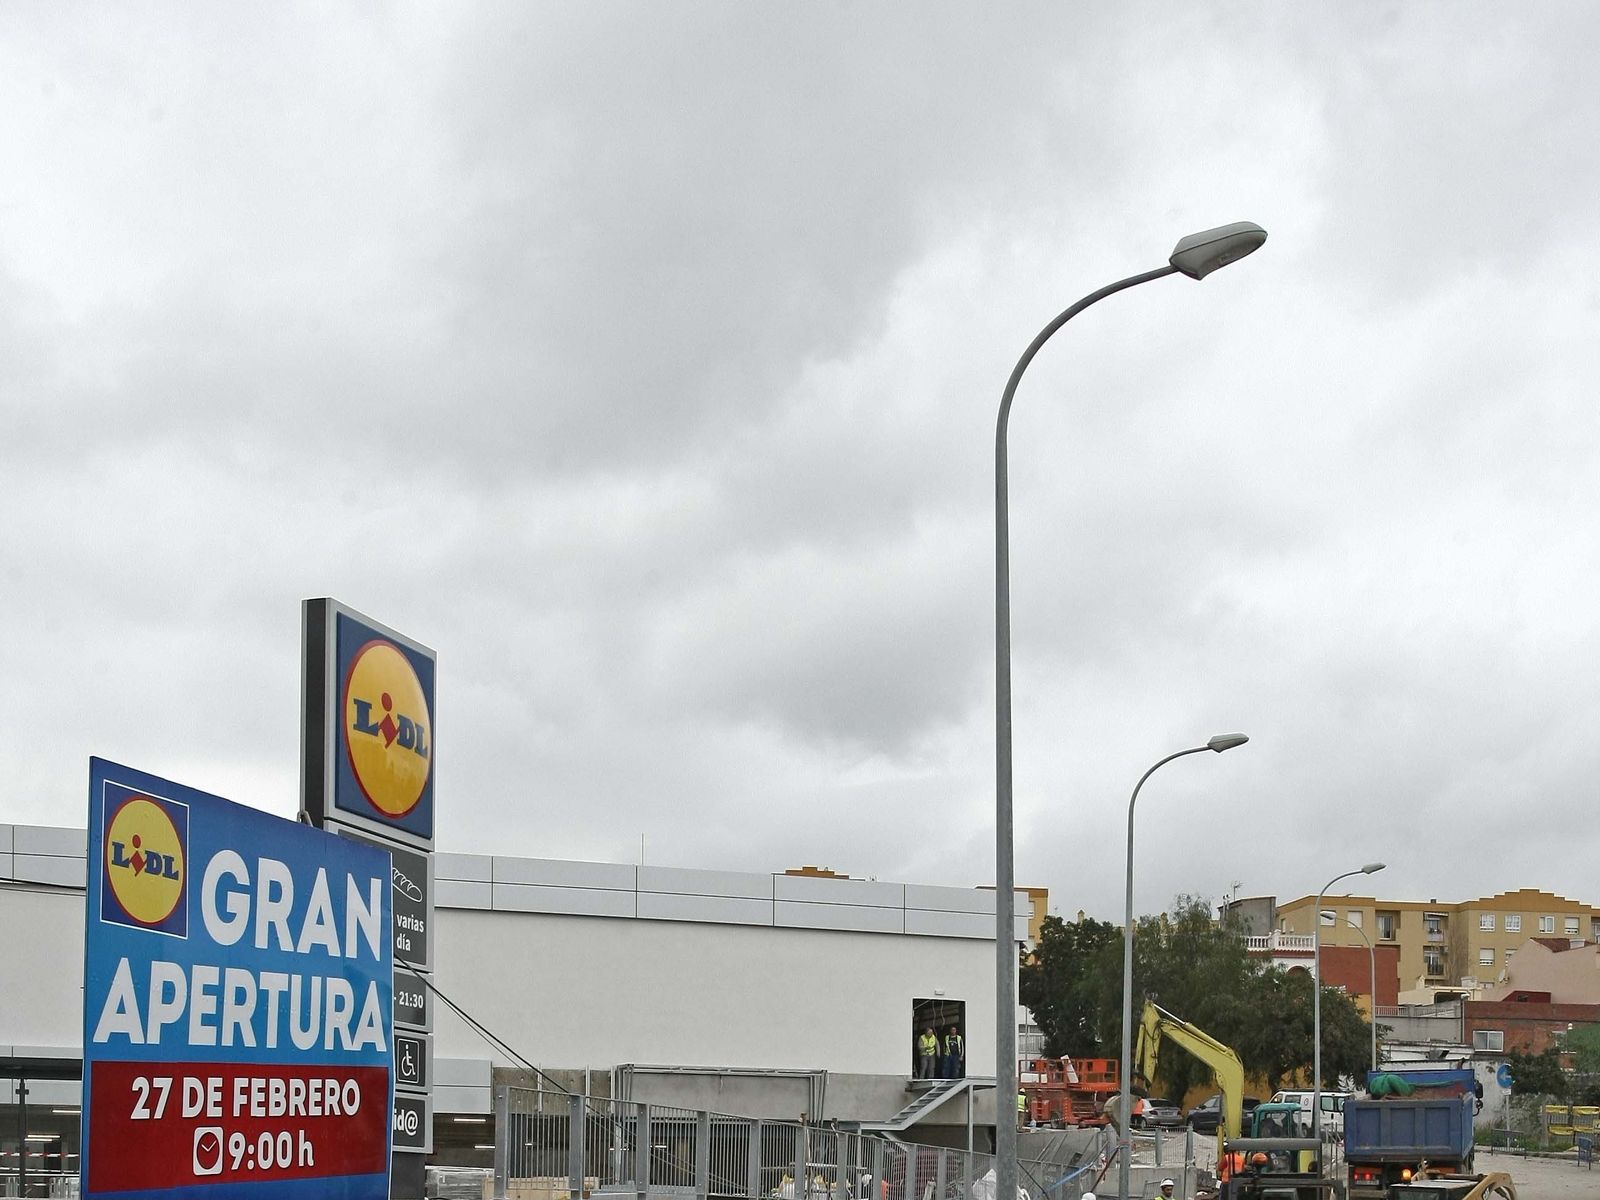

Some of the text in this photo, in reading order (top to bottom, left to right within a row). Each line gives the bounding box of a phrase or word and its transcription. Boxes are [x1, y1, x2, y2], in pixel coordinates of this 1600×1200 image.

[201, 849, 382, 962] GRAN
[396, 914, 425, 933] varias
[396, 933, 412, 952] día
[92, 957, 388, 1052] APERTURA
[399, 991, 424, 1009] 21:30
[130, 1076, 361, 1120] 27 DE FEBRERO
[228, 1129, 315, 1171] 9:00 h
